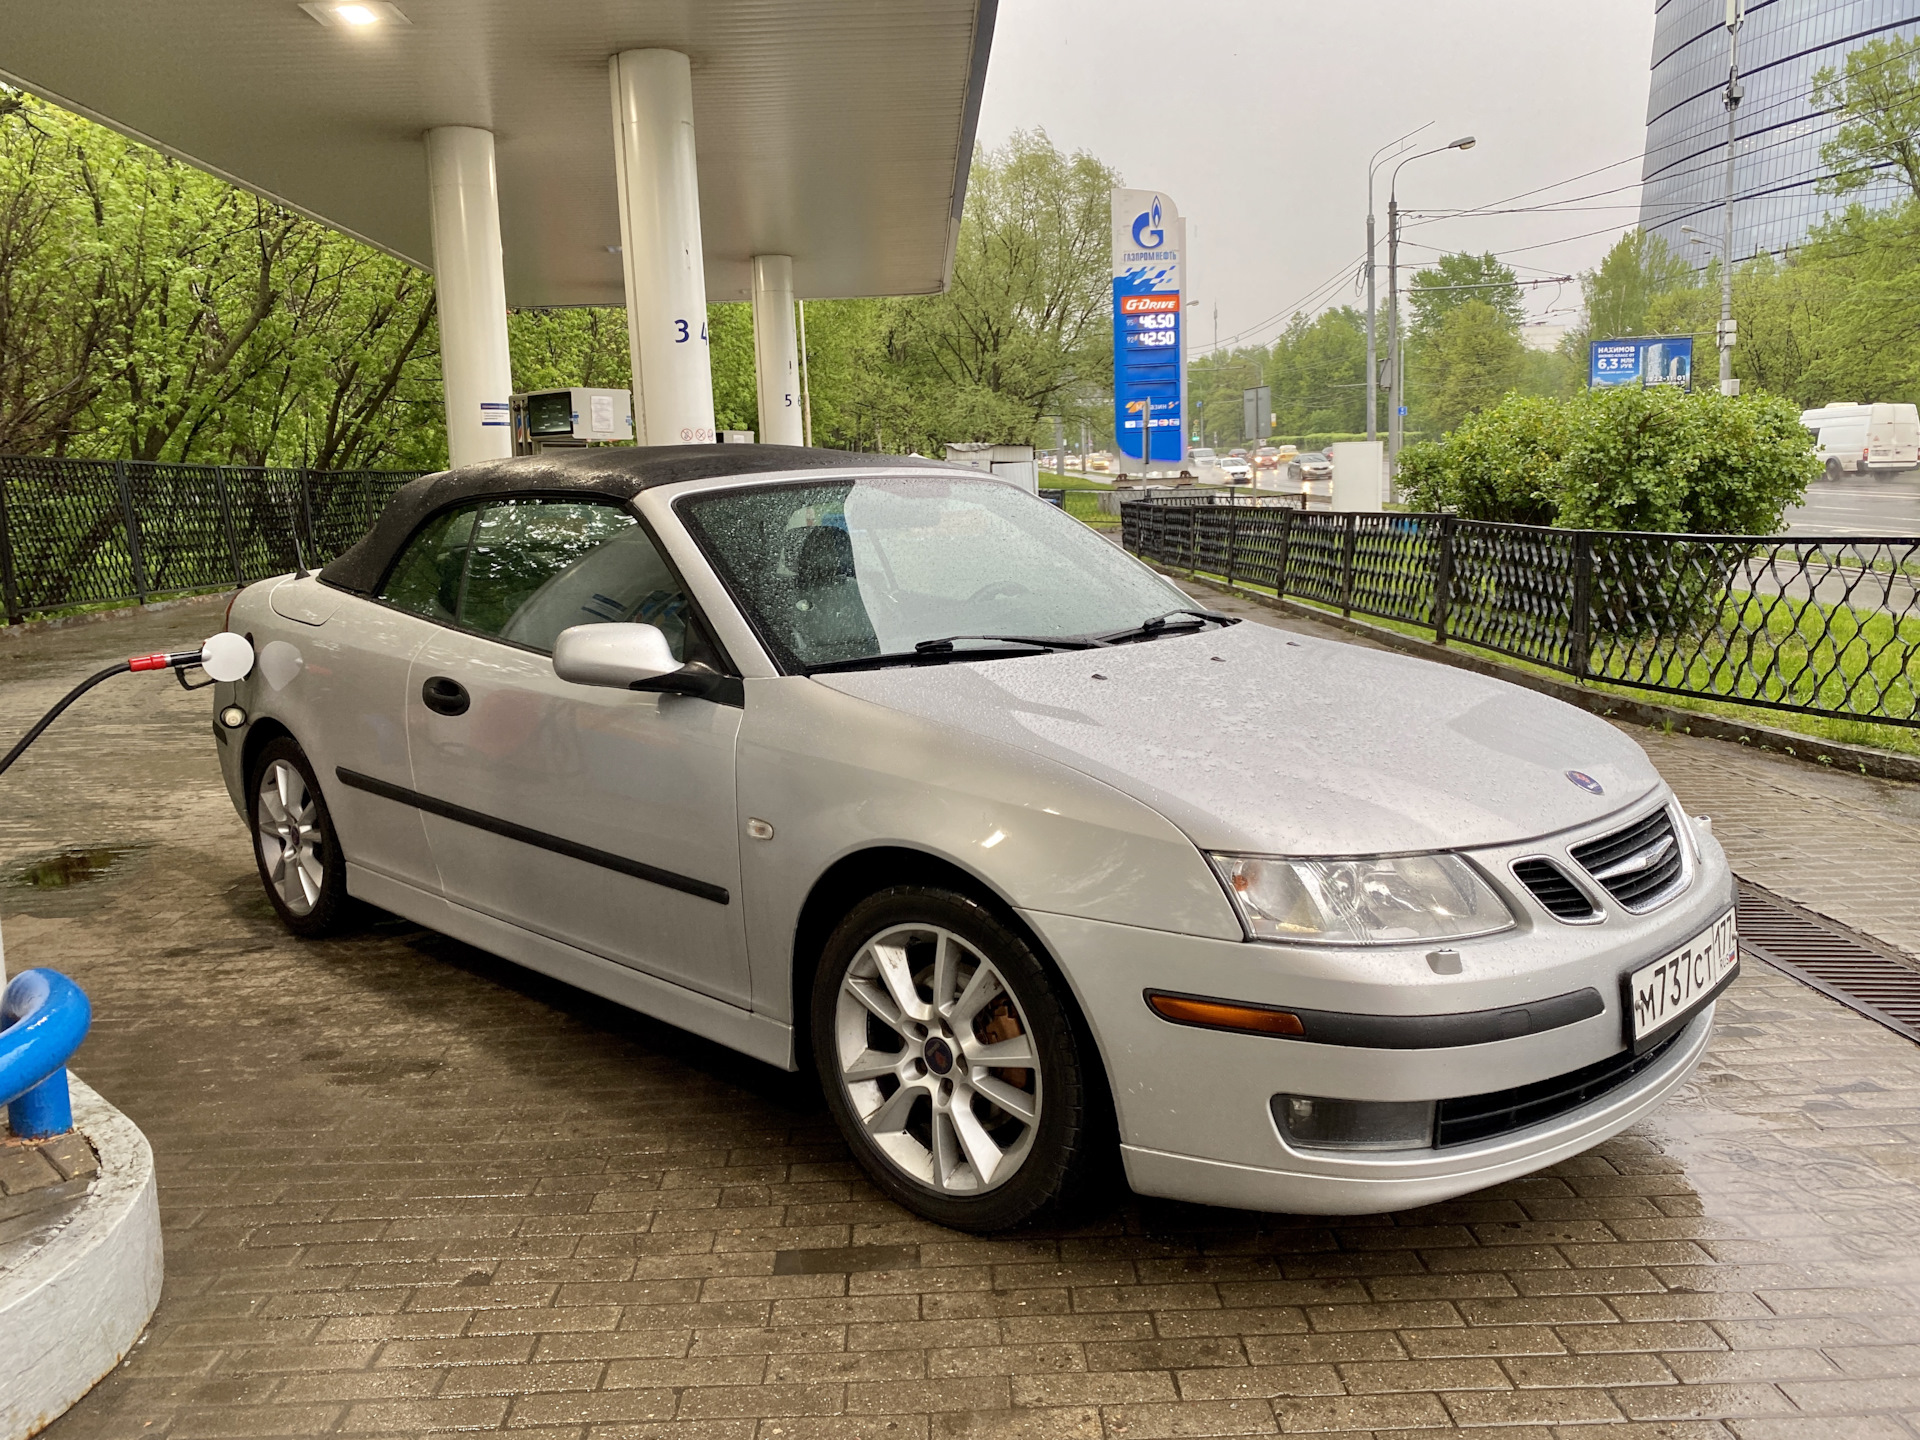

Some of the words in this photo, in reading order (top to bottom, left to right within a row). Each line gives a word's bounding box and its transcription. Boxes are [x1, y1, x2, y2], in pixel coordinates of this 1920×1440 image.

[1123, 251, 1177, 263] ГАЗПРОМНЕФТЬ
[674, 319, 690, 343] 3
[700, 321, 708, 346] 4
[1139, 331, 1175, 346] 42.50
[1598, 346, 1635, 354] НАХИМОВ
[1598, 358, 1618, 370] 6,3
[785, 394, 792, 407] 5
[1714, 914, 1733, 960] 177
